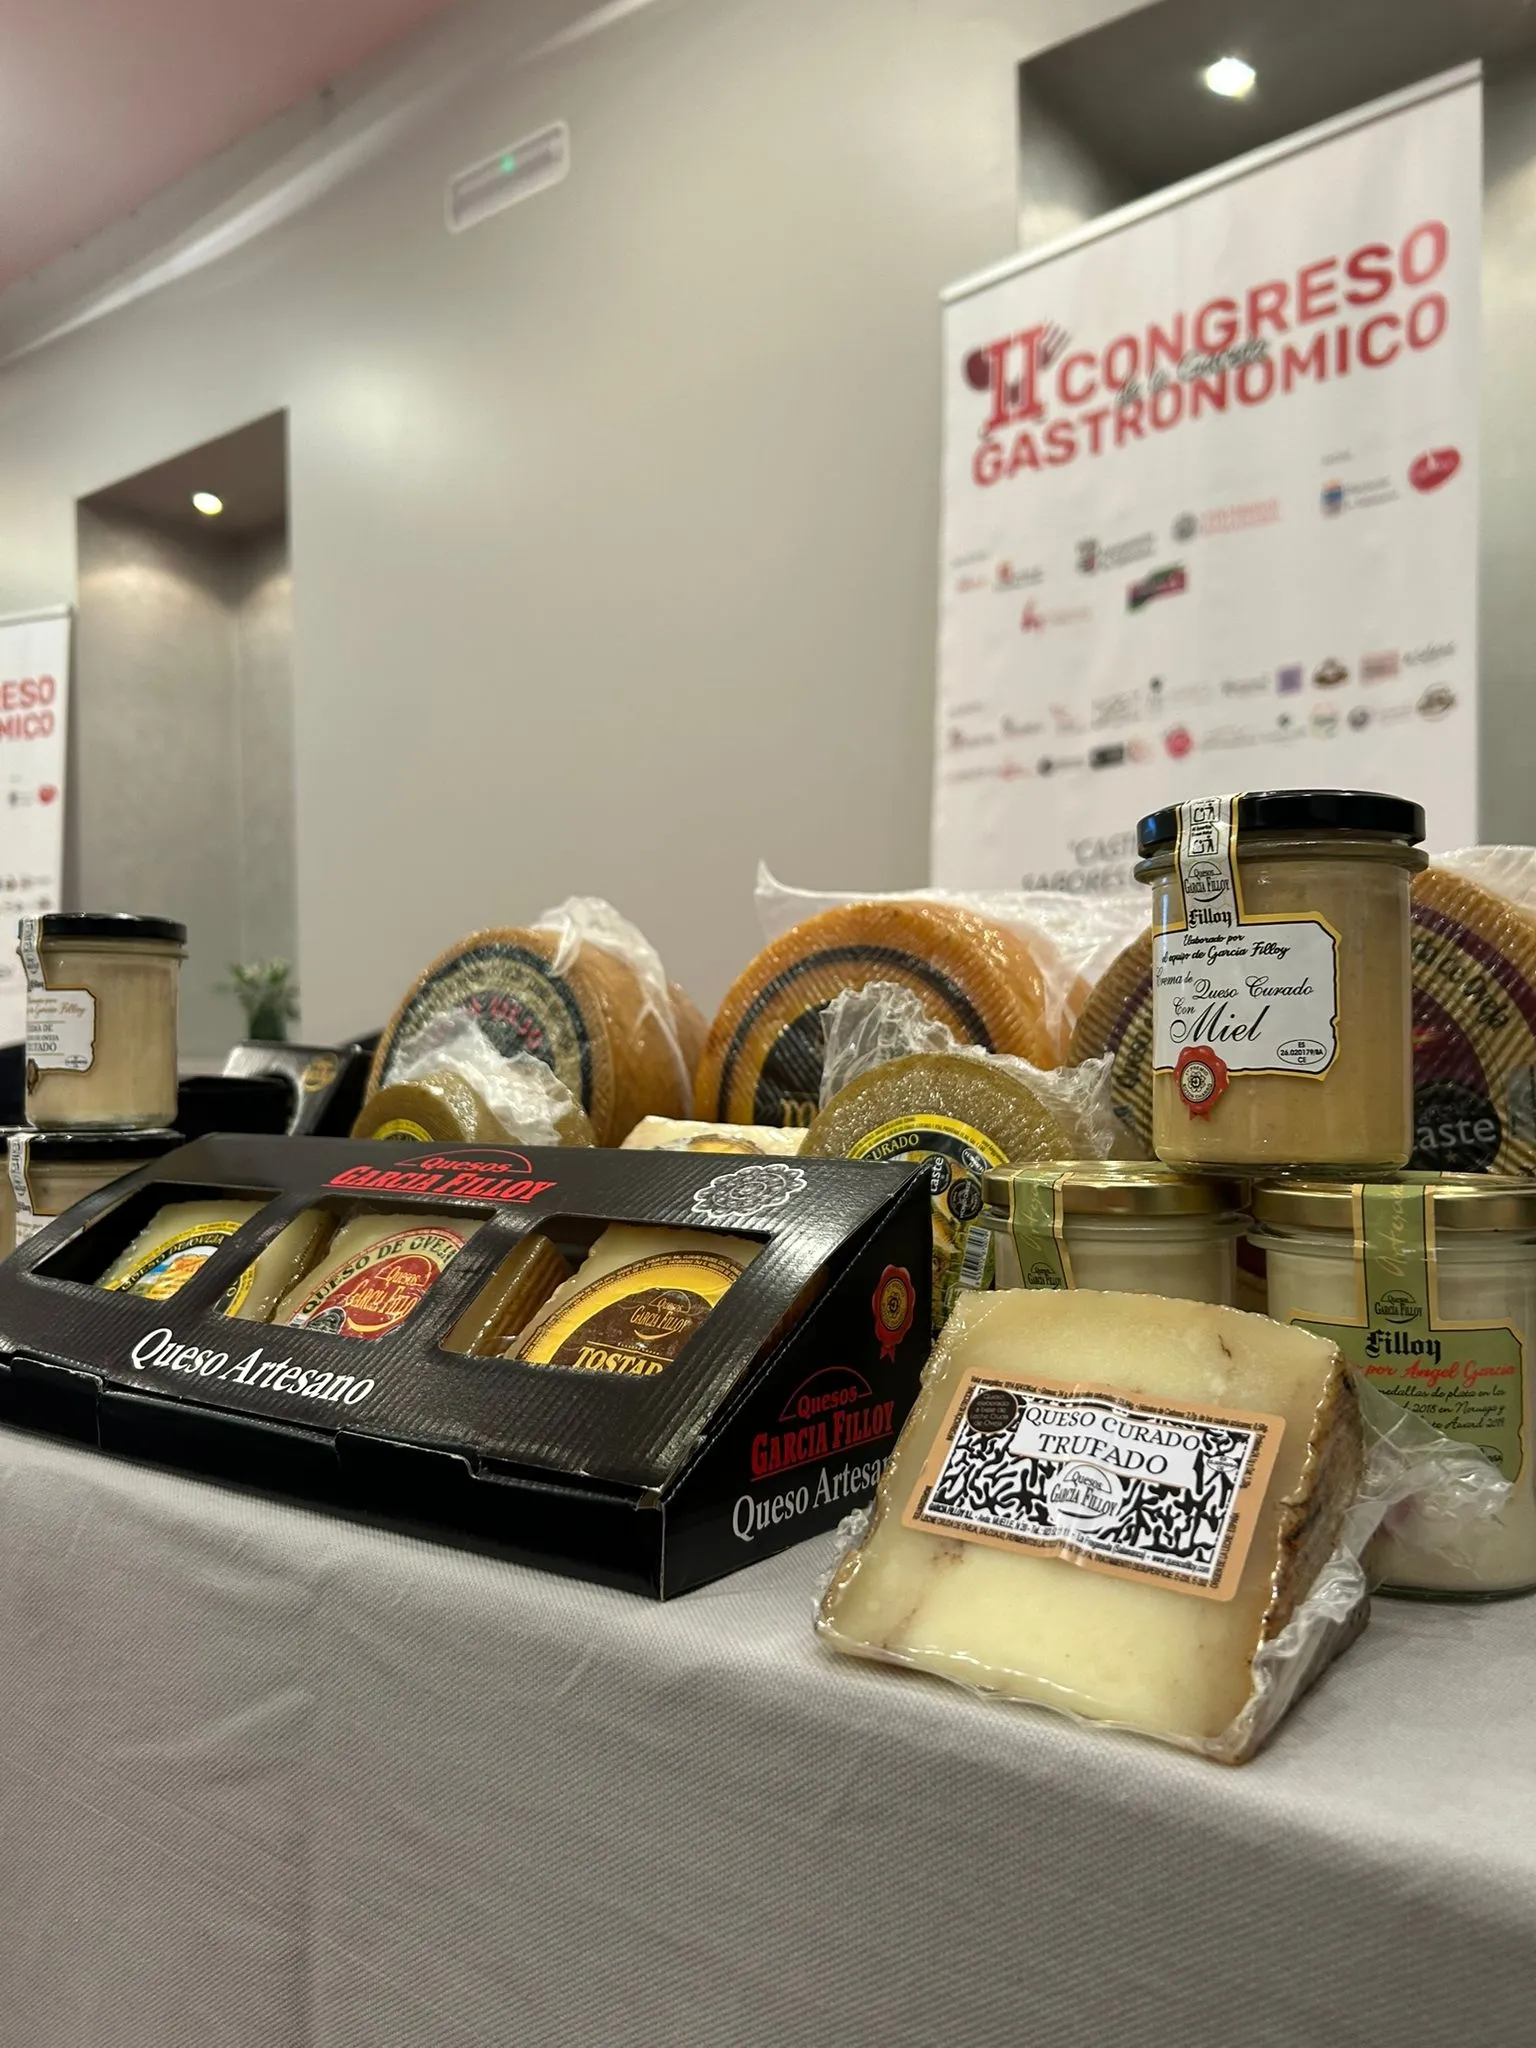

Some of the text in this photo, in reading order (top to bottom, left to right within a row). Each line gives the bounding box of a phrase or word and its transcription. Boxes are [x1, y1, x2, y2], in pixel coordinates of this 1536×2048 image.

[1056, 219, 1450, 407] CONGRESO
[1189, 908, 1232, 928] Filloy
[1183, 934, 1245, 947] Elaborado por
[1192, 950, 1206, 960] de
[1250, 941, 1291, 960] Filloy
[1192, 976, 1314, 1000] Queso Curado
[1169, 1001, 1271, 1043] Miel
[1173, 997, 1196, 1015] Con
[1412, 1118, 1497, 1150] aste
[420, 1157, 513, 1173] Quesos
[330, 1165, 557, 1201] GARCIA FILLOY
[302, 1256, 371, 1315] QUESO
[376, 1239, 405, 1260] DE
[1365, 1329, 1441, 1364] Filloy
[129, 1328, 376, 1405] Queso Artesano
[1365, 1364, 1397, 1377] por
[797, 1386, 859, 1419] Quesos
[751, 1401, 895, 1476] GARCIA FILLOY
[1025, 1406, 1201, 1451] QUESO CURADO
[1038, 1433, 1168, 1475] TRUFADO
[1072, 1471, 1103, 1492] Quesos
[732, 1486, 809, 1542] Queso
[1081, 1486, 1118, 1517] FILLOY
